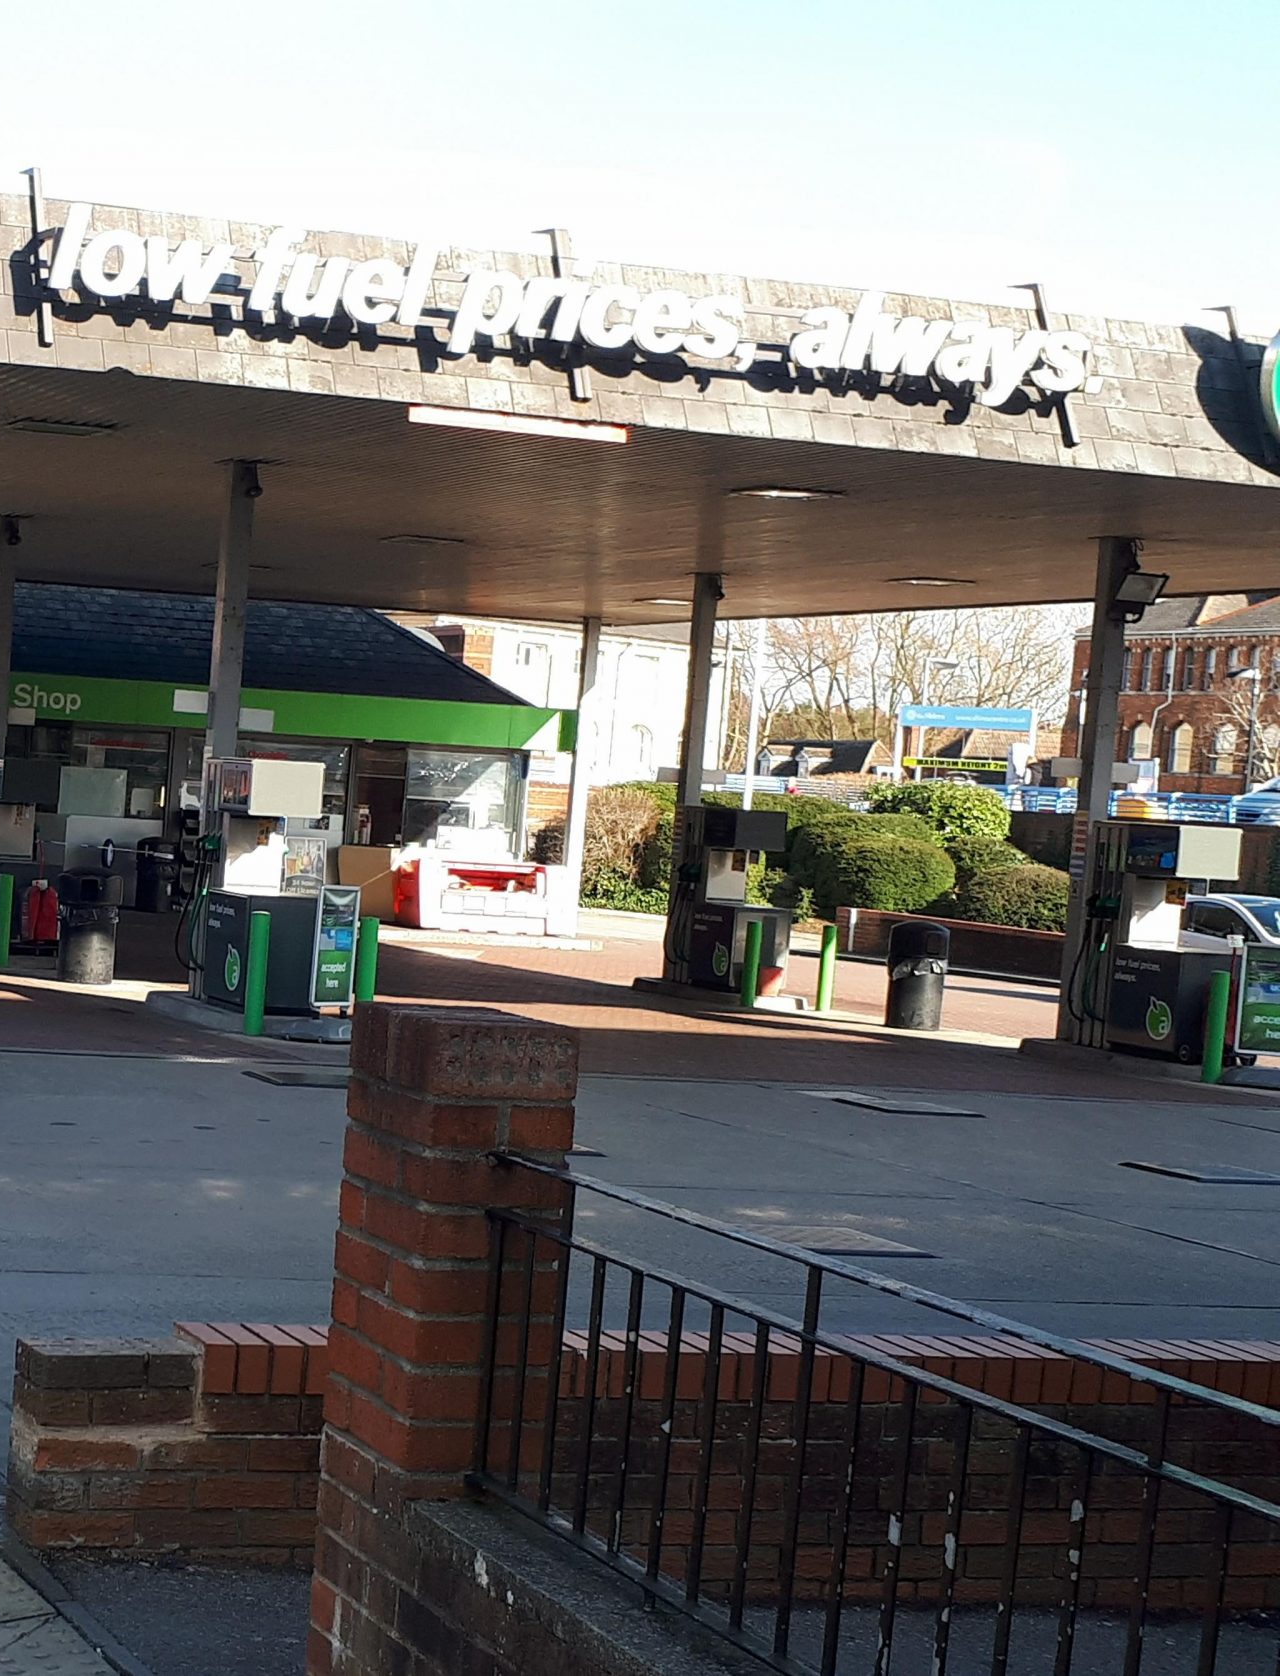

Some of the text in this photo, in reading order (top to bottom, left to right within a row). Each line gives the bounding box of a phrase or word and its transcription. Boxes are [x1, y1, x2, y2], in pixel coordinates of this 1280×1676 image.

[48, 202, 236, 306] low
[248, 228, 440, 328] fuel
[14, 683, 82, 714] Shop
[916, 759, 959, 768] MAXIMUM
[961, 761, 992, 769] HEIGHT
[321, 961, 347, 974] accepted
[325, 977, 339, 988] here
